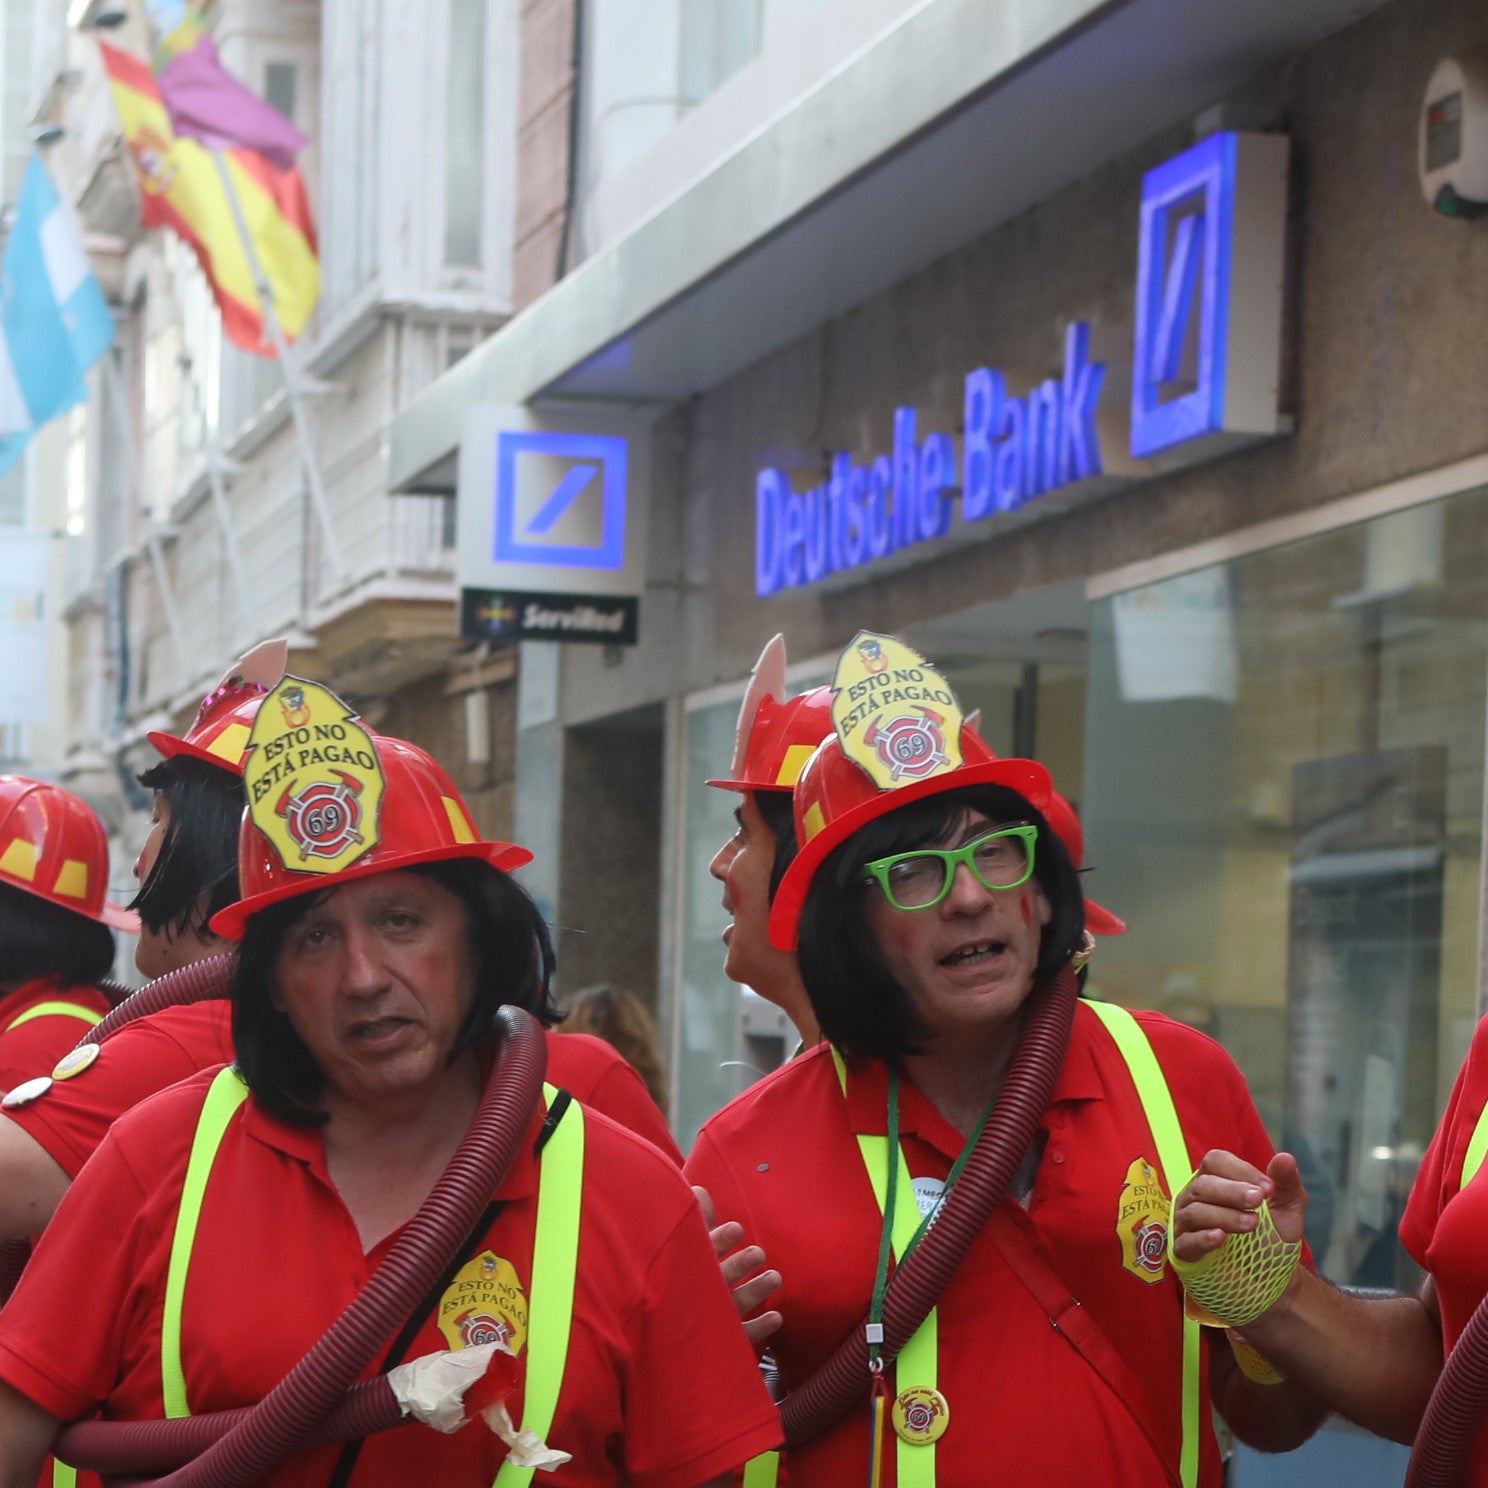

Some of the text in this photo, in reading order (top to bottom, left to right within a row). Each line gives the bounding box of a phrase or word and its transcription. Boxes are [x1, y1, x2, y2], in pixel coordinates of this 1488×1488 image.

[756, 321, 1106, 597] Deutsche Bank
[521, 602, 625, 632] ServiRed
[847, 669, 923, 702] ESTO NO
[840, 686, 953, 738] ESTÁ PAGAO
[263, 724, 346, 762] ESTO NO
[896, 734, 927, 760] 69
[251, 745, 375, 804] ESTÁ PAGAO
[307, 804, 342, 836] 69
[1133, 1185, 1157, 1197] ESTO
[1122, 1196, 1150, 1219] ESTÁ
[458, 1280, 516, 1299] ESTO NO
[442, 1291, 527, 1327] ESTÁ PAGAO
